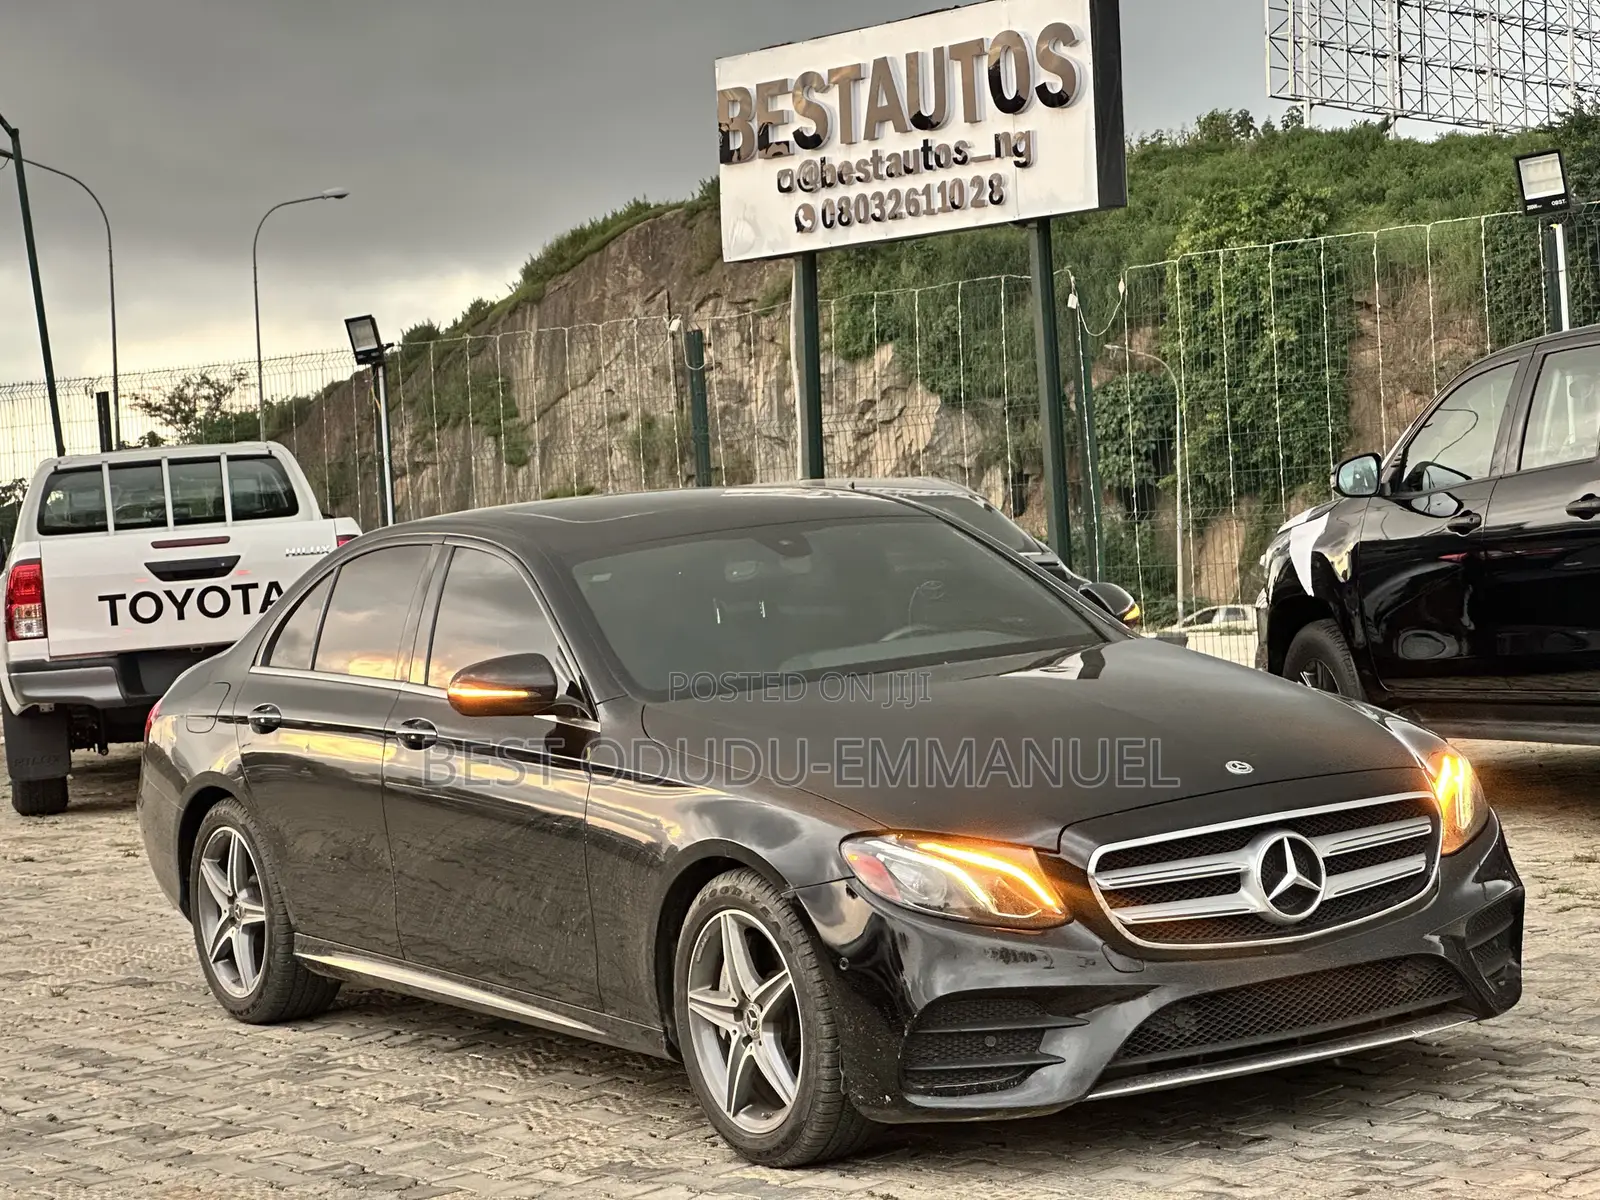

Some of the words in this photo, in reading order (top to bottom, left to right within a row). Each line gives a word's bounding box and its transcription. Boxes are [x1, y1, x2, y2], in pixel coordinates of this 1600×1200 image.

[717, 22, 1084, 165] BESTAUTOS
[797, 129, 1036, 194] @bestautos_ng
[822, 173, 1008, 229] 08032611028
[285, 545, 331, 558] HILUX
[98, 581, 284, 627] TOYOTA
